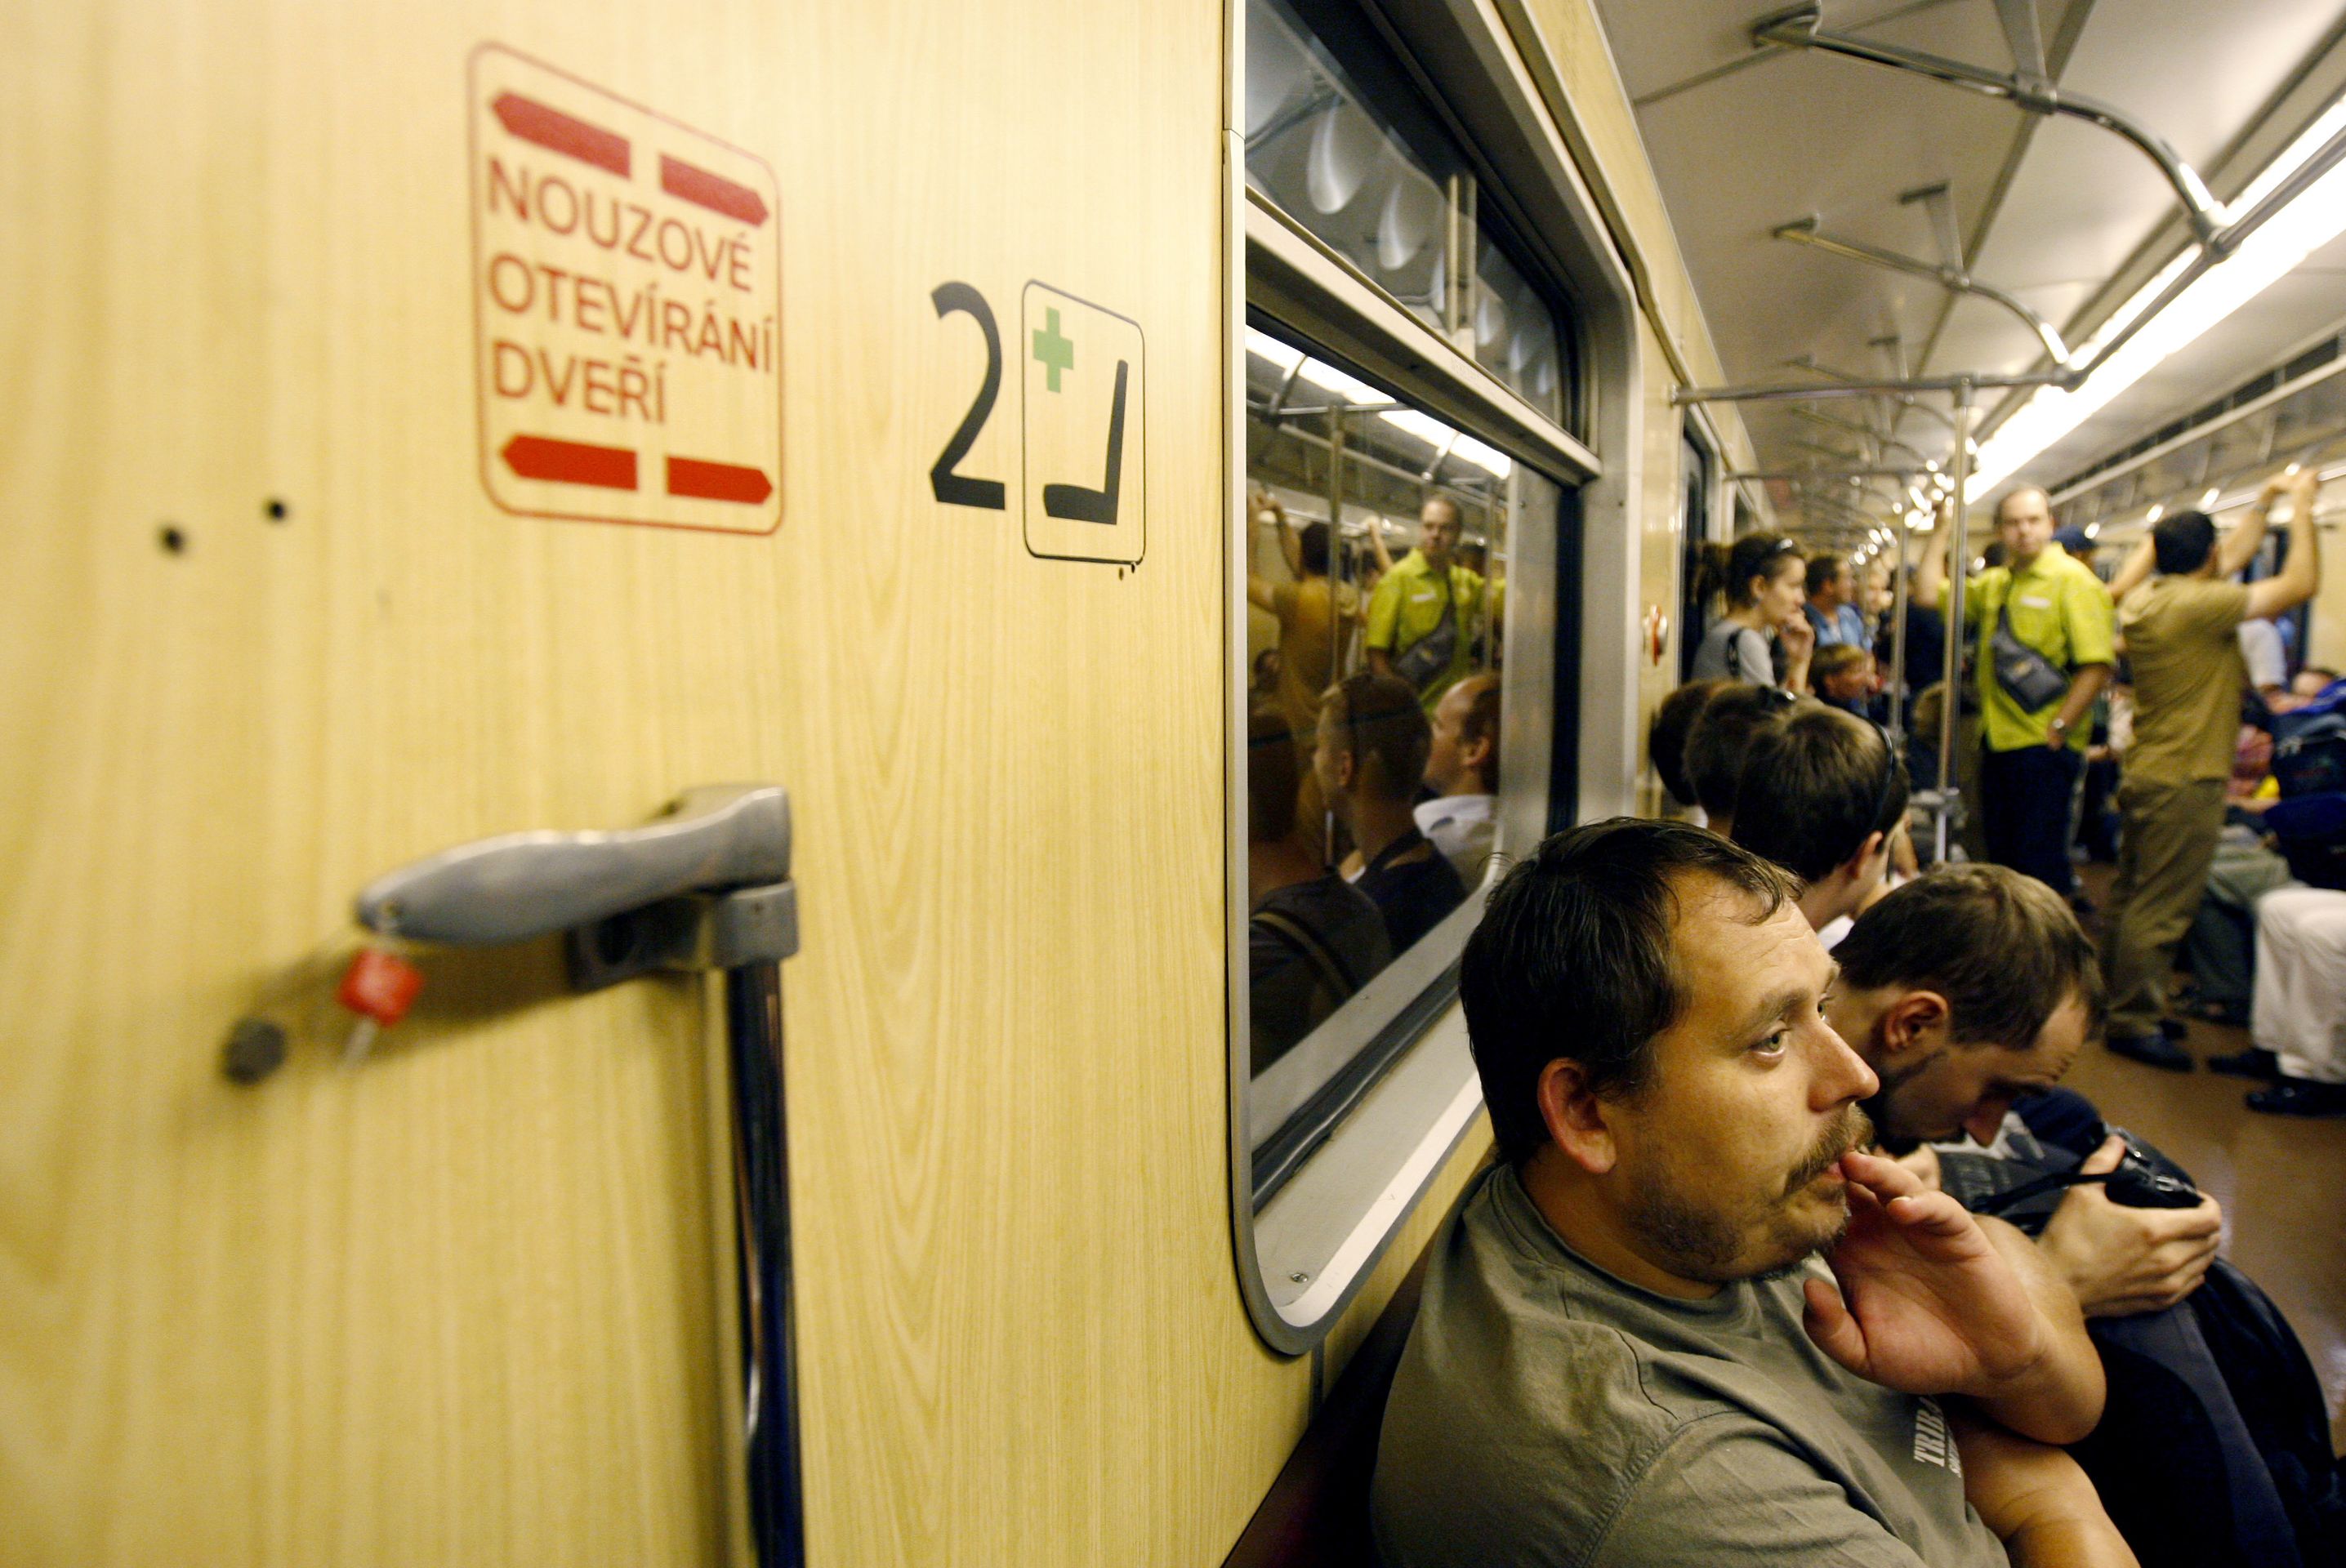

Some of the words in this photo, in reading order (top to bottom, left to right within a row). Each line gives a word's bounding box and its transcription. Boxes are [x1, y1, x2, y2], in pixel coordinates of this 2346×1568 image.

[489, 155, 752, 292] NOUZOVÉ
[488, 252, 773, 372] OTEVÍRÁNÍ
[492, 339, 667, 423] DVEŘÍ
[930, 280, 1006, 510] 2
